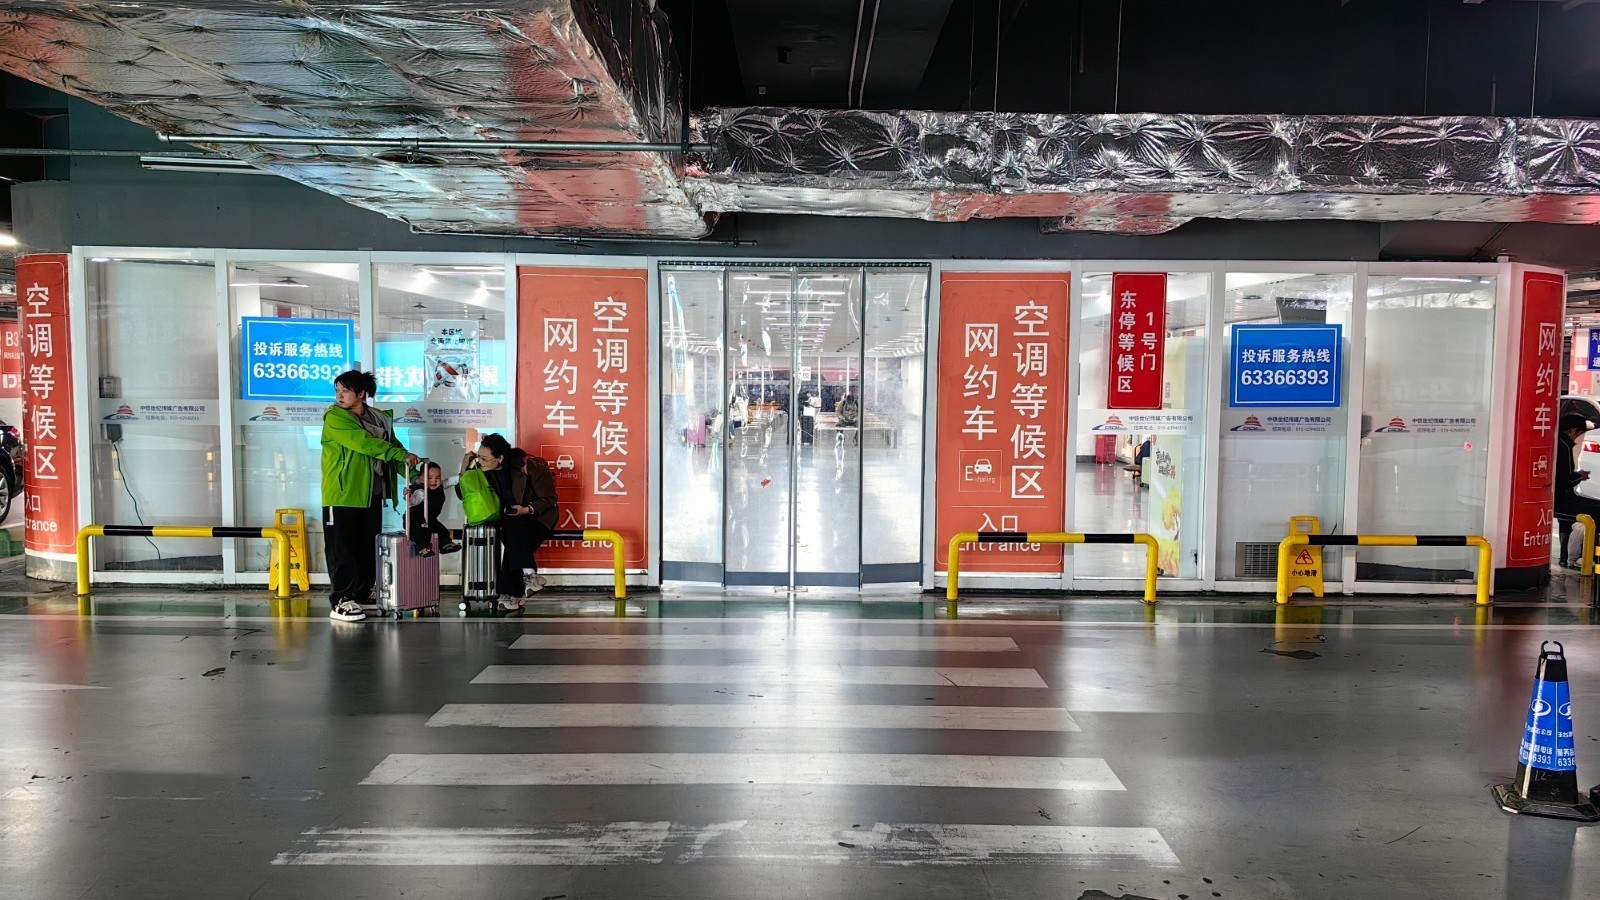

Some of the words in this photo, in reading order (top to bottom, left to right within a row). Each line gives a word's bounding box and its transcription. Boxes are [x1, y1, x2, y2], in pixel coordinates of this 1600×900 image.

[253, 341, 343, 358] 投诉服务热线
[1117, 290, 1137, 393] 东停等候区
[1140, 311, 1158, 371] 1号门
[1242, 348, 1331, 363] 投诉服务热线
[26, 282, 58, 479] 空调等候区
[253, 362, 342, 380] 63366393
[543, 317, 579, 436] 网约车
[1241, 369, 1329, 385] 63366393
[1533, 322, 1556, 437] 网约车
[961, 323, 999, 441] 网约车
[592, 296, 629, 495] 空调等候区
[1010, 300, 1050, 499] 空调等候区
[560, 508, 601, 529] 入口
[977, 512, 1018, 533] 入口
[540, 539, 614, 549] Entranc
[958, 542, 1041, 552] Entrance
[1291, 569, 1317, 577] 小心地滑
